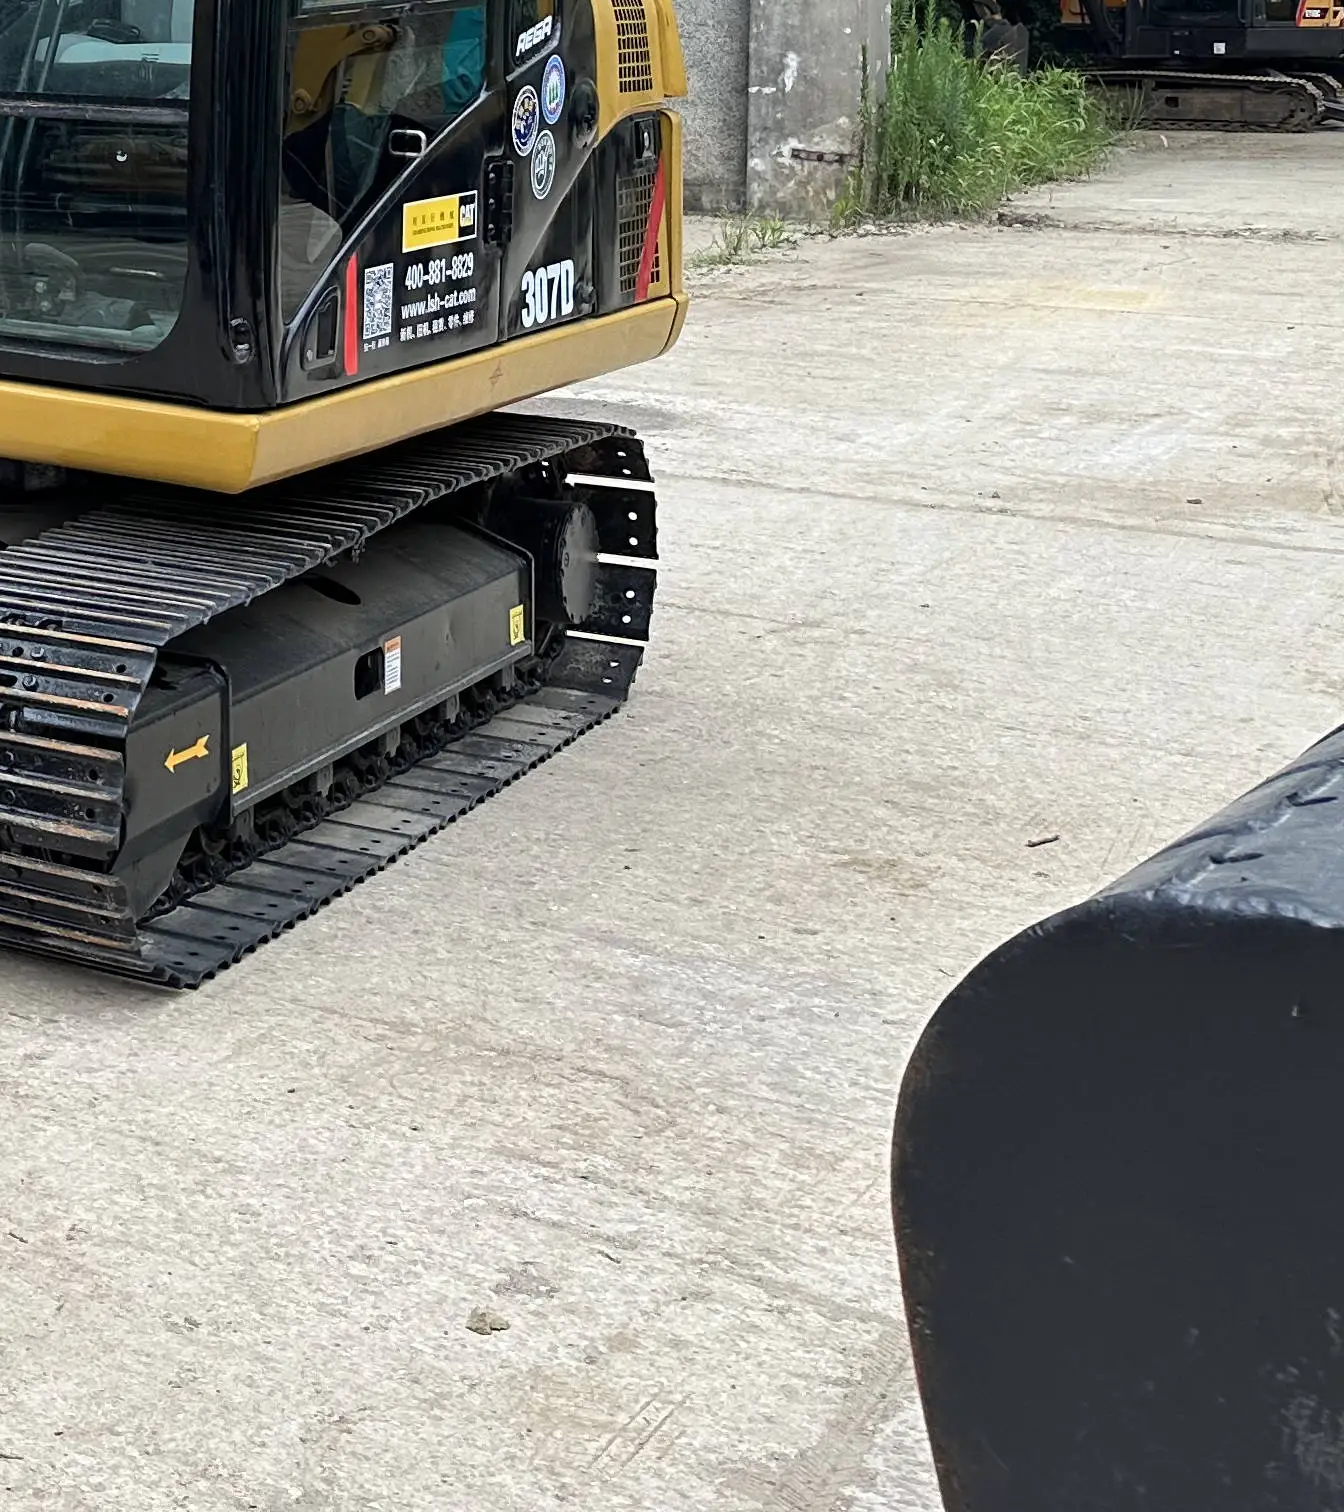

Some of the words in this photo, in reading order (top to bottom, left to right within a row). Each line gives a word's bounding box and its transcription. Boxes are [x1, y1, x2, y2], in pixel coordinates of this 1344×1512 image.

[459, 203, 475, 228] CAT
[404, 251, 474, 291] 400-881-8829
[521, 259, 575, 328] 307D
